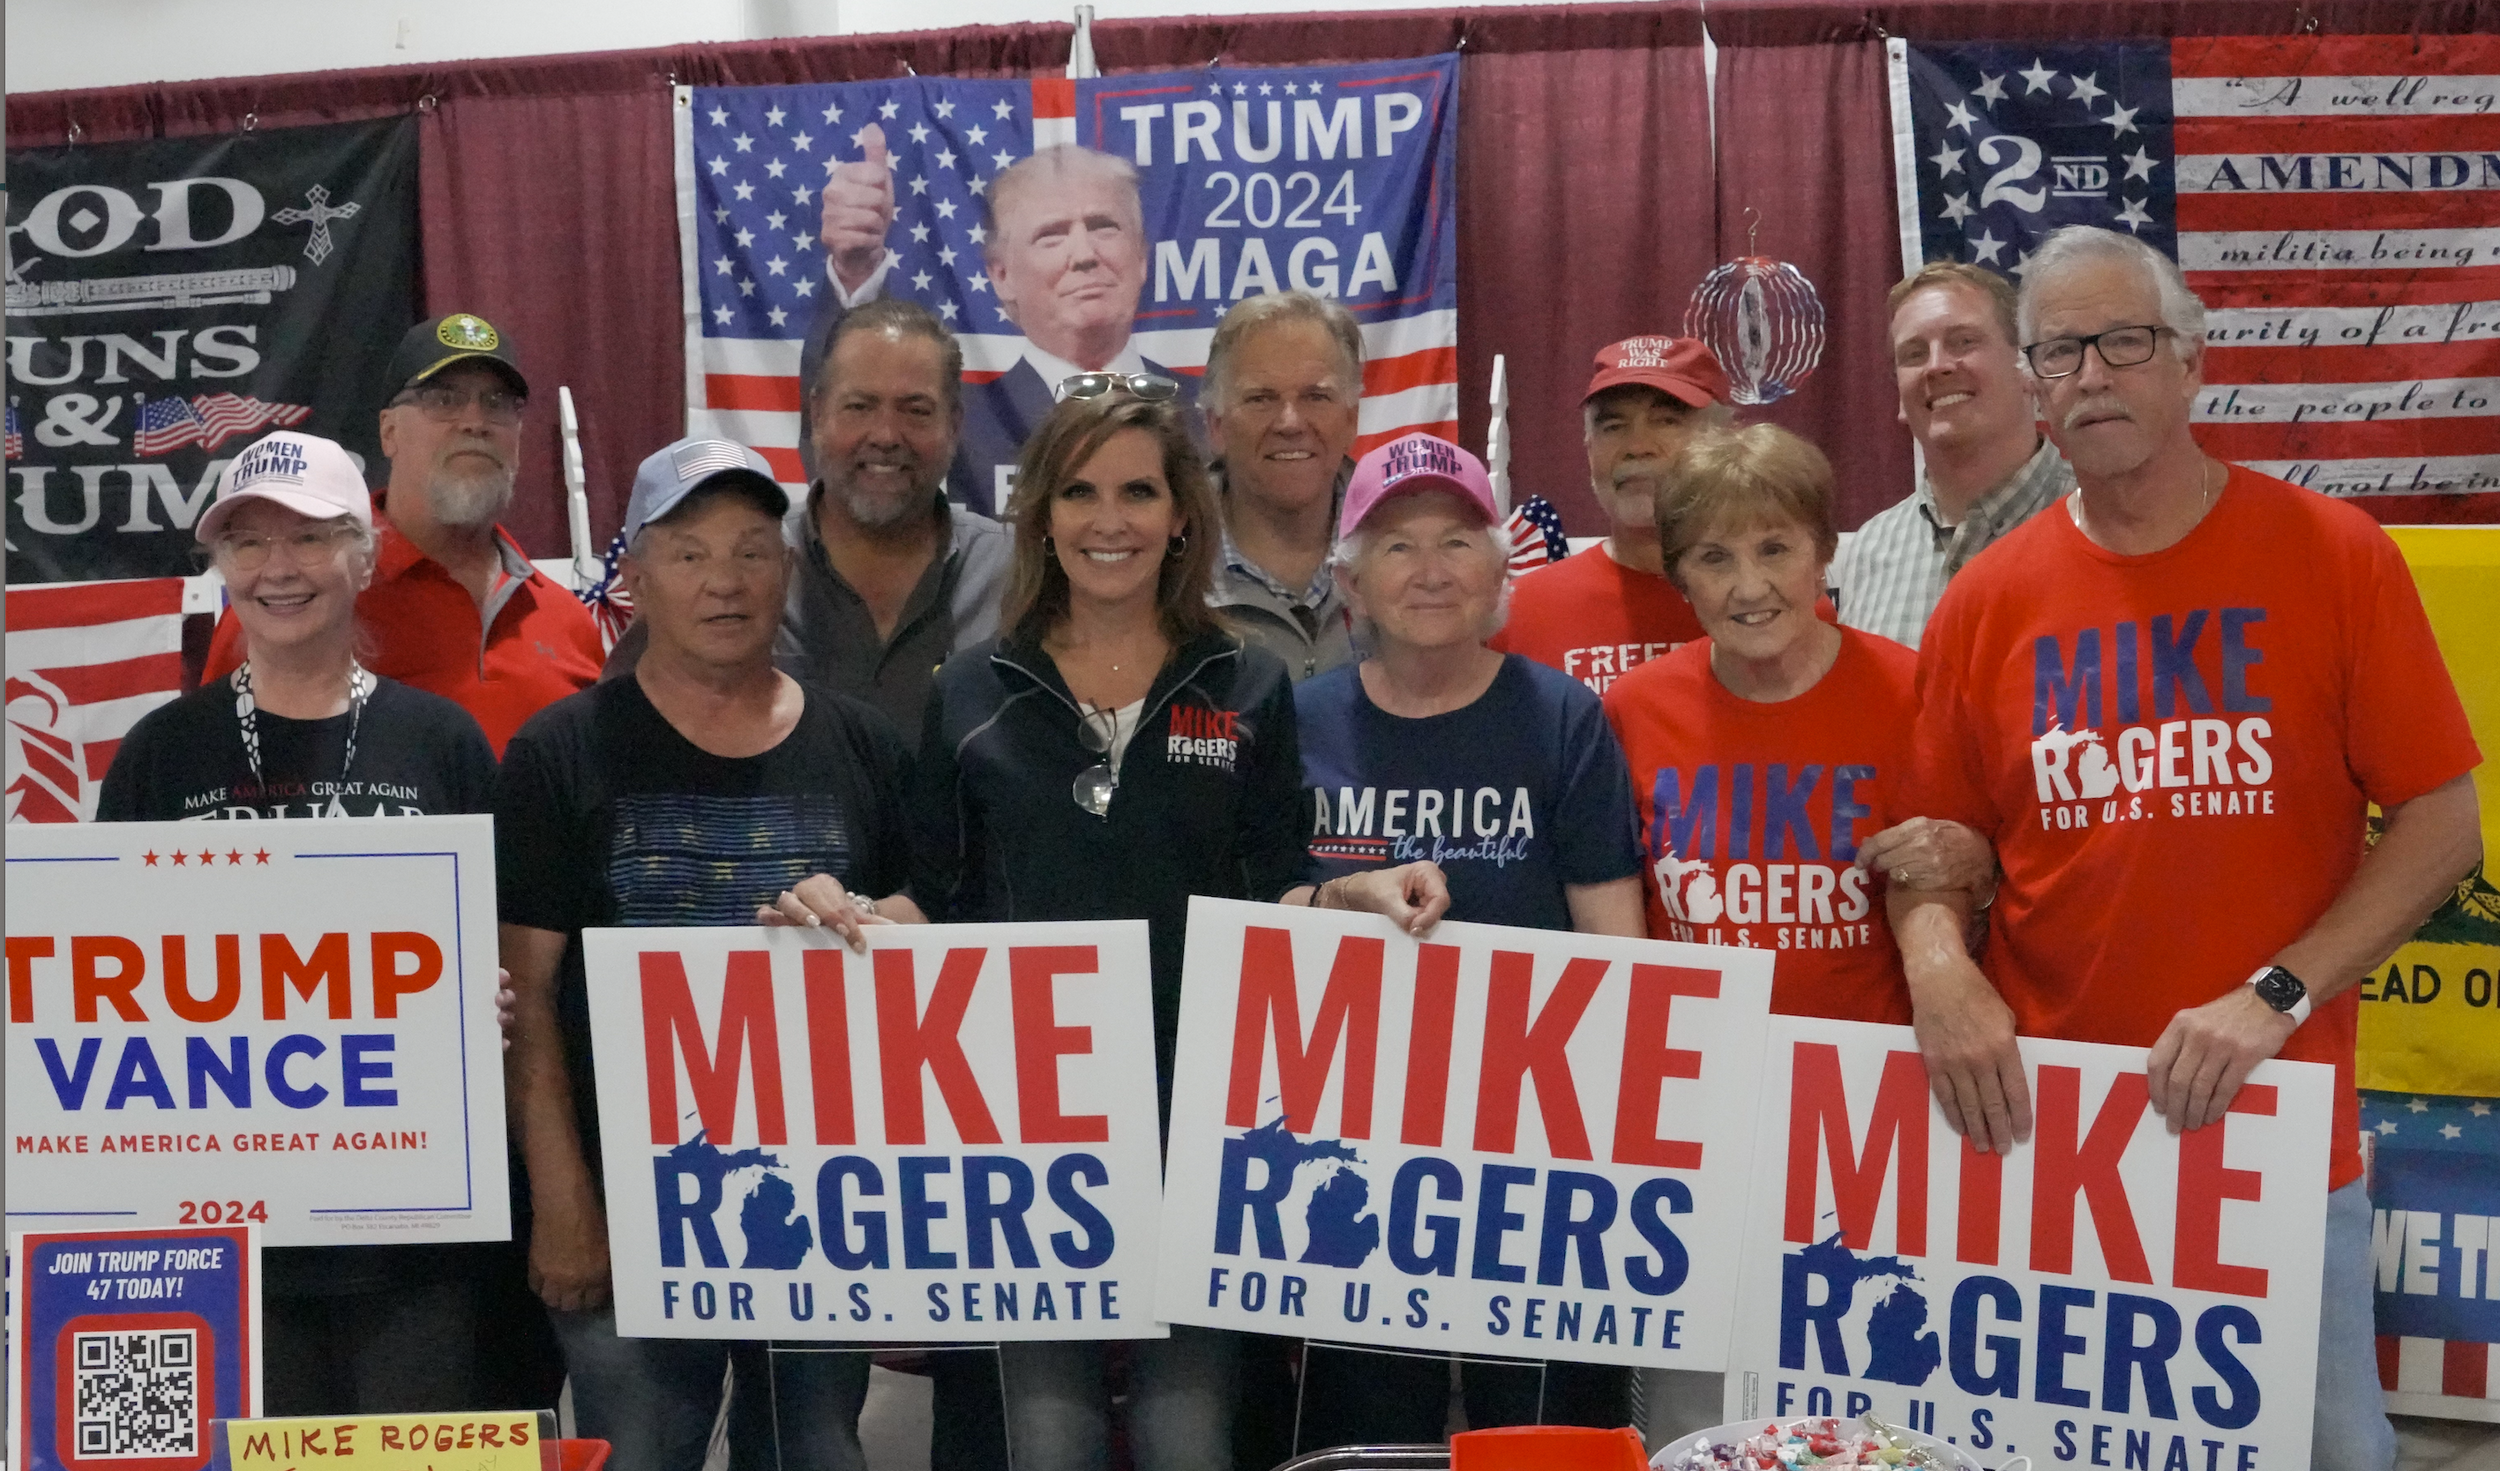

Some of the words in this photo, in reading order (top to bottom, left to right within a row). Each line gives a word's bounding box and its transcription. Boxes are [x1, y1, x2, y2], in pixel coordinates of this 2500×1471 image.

[2332, 76, 2428, 106] well
[2432, 93, 2495, 113] reg
[1119, 91, 1424, 167] TRUMP
[5, 177, 266, 258] OD
[1204, 169, 1363, 228] 2024
[1153, 232, 1399, 302] MAGA
[2220, 231, 2356, 262] militia
[2370, 233, 2475, 266] being
[1621, 338, 1673, 350] TRUMP
[2340, 305, 2396, 348] of
[2403, 323, 2428, 338] a
[1617, 357, 1668, 368] RIGHT
[1629, 348, 1660, 358] WAS
[35, 393, 122, 447] &
[2207, 389, 2266, 415] the
[2291, 382, 2434, 422] people
[2451, 390, 2488, 410] to
[241, 441, 304, 465] WOMEN
[1382, 454, 1463, 478] TRUMP
[1389, 439, 1455, 459] WOMEN
[233, 456, 307, 486] TRUMP
[2323, 473, 2393, 494] not
[2409, 464, 2454, 492] be
[2032, 608, 2273, 735] MIKE
[1169, 704, 1240, 741] MIKE
[1167, 755, 1190, 763] FOR
[185, 787, 227, 810] MAKE
[368, 782, 418, 800] AGAIN
[1313, 787, 1534, 839] AMERICA
[1651, 763, 1877, 861] MIKE
[2041, 805, 2089, 831] FOR
[2102, 796, 2153, 825] U.S.
[2171, 790, 2275, 818] SENATE
[1389, 834, 1426, 860] the
[1432, 835, 1528, 868] beautiful
[1707, 928, 1759, 948] U.S.
[1777, 924, 1870, 949] SENATE
[5, 930, 444, 1023] TRUMP
[638, 945, 1109, 1146] MIKE
[1225, 925, 1723, 1170] MIKE
[34, 1034, 400, 1111] VANCE
[16, 1135, 89, 1154] MAKE
[101, 1134, 222, 1153] AMERICA
[233, 1133, 321, 1152] GREAT
[332, 1131, 428, 1150] AGAIN!
[1783, 1041, 2278, 1299] MIKE
[179, 1201, 268, 1224] 2024
[49, 1252, 92, 1275] JOIN
[97, 1250, 160, 1273] TRUMP
[164, 1248, 224, 1271] FORCE
[2370, 1209, 2441, 1296] WE
[87, 1278, 112, 1301] 47
[116, 1275, 183, 1299] TODAY!
[663, 1281, 756, 1320] FOR
[789, 1281, 893, 1322] U.S.
[927, 1280, 1121, 1321] SENATE
[1208, 1268, 1308, 1317] FOR
[1344, 1281, 1450, 1331] U.S.
[1487, 1294, 1685, 1350] SENATE
[243, 1425, 358, 1461] MIKE
[381, 1422, 529, 1451] ROGERS
[1776, 1382, 1872, 1418] FOR
[1909, 1400, 2015, 1453] U.S.
[2054, 1419, 2259, 1471] SENATE
